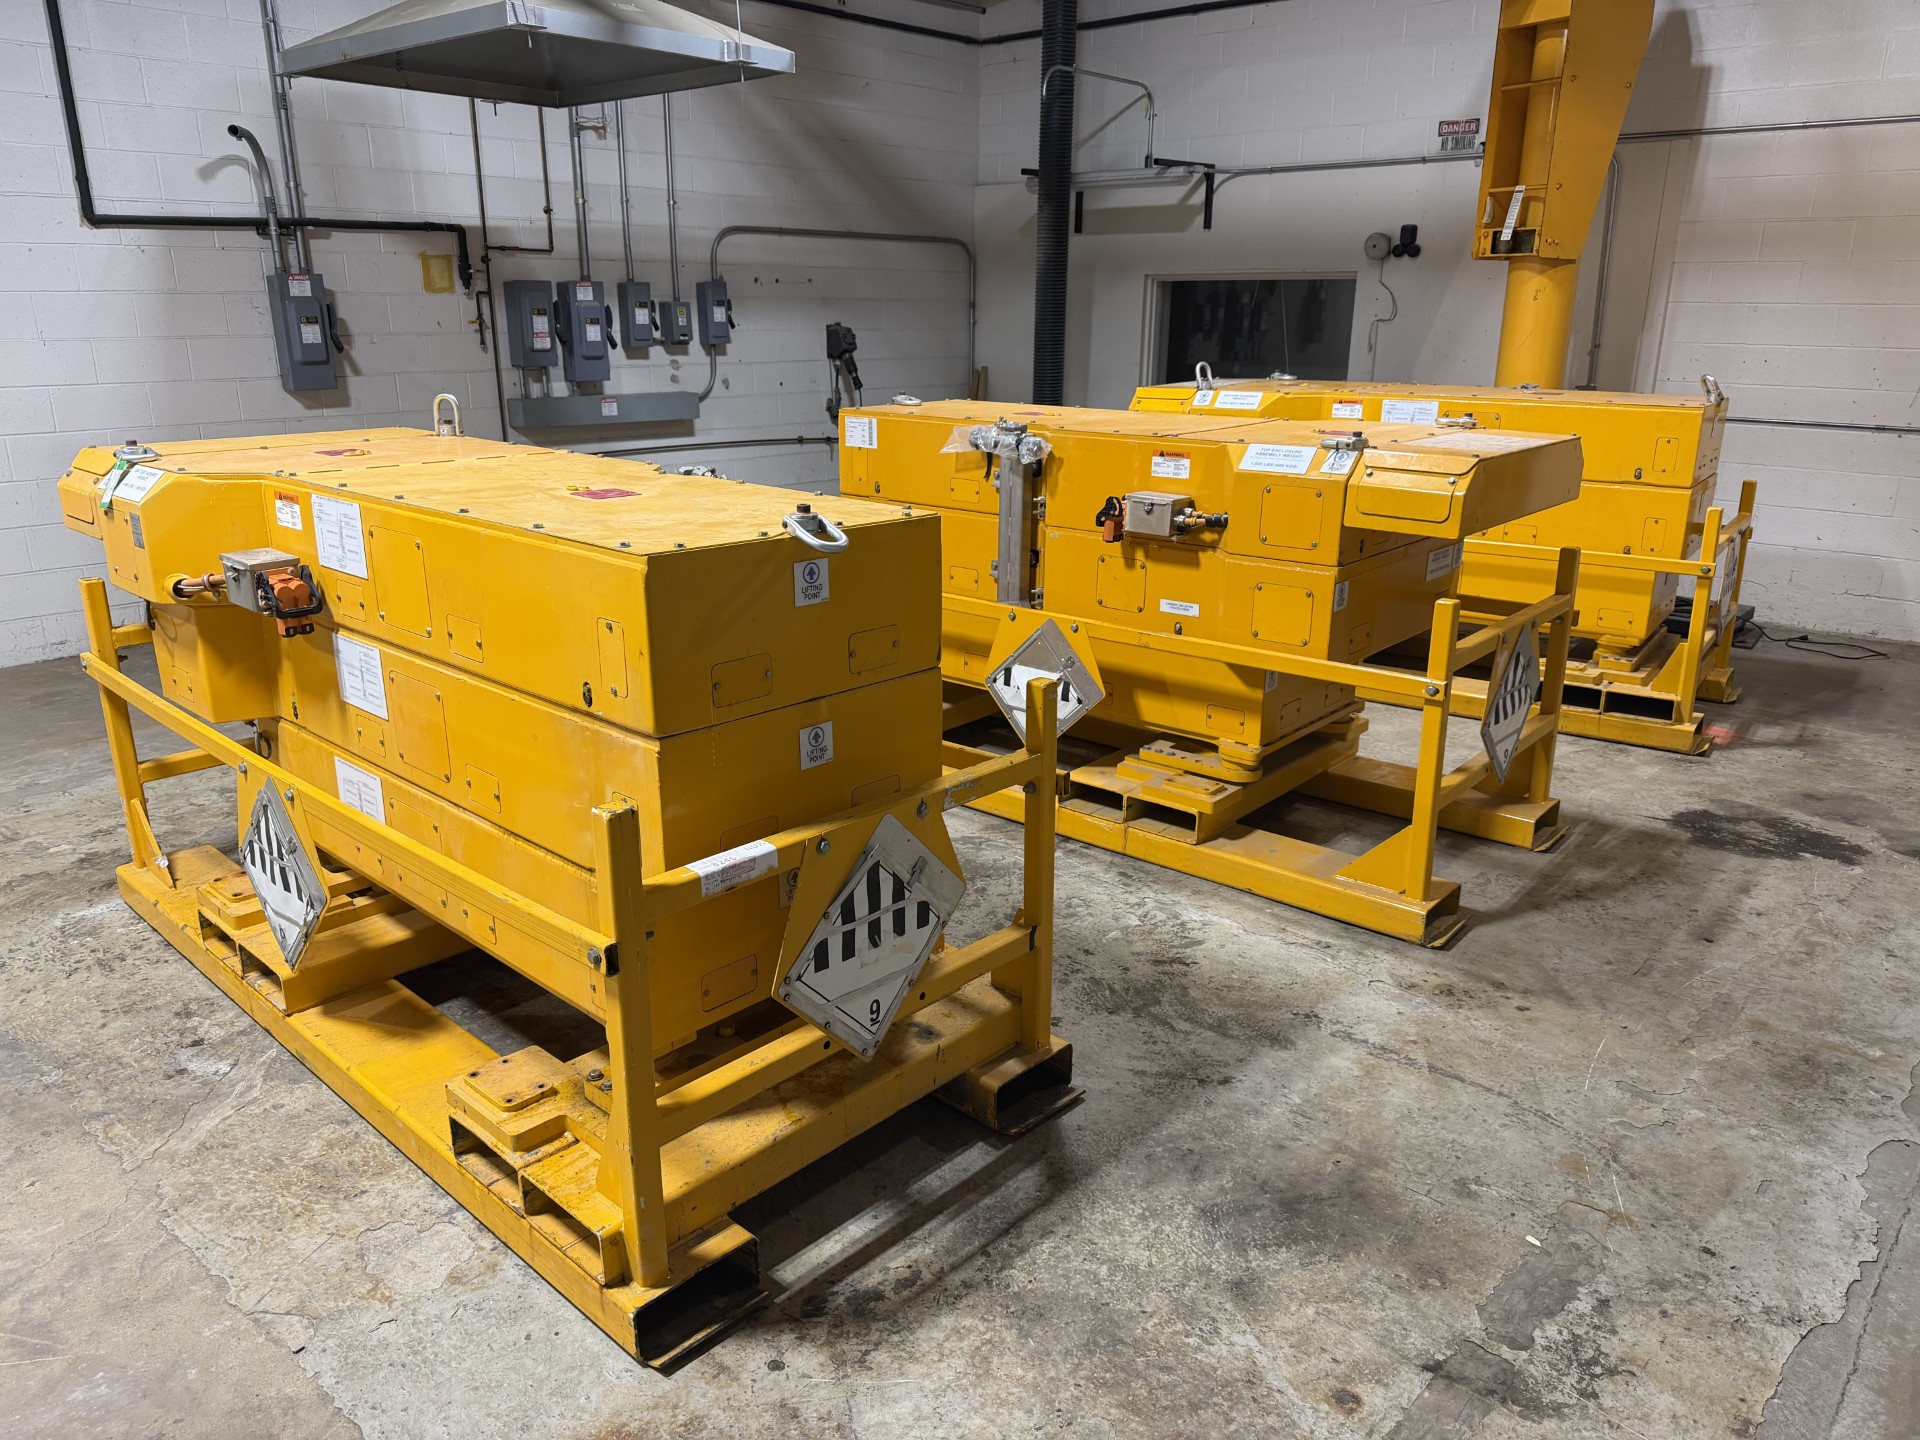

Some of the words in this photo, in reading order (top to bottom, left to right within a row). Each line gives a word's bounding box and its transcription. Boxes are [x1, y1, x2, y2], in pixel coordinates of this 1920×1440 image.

[1442, 122, 1476, 133] DANGER
[801, 584, 823, 594] LIFTING
[803, 591, 821, 600] POINT
[806, 745, 828, 757] LIFTING
[809, 752, 826, 763] POINT
[869, 998, 881, 1023] 9
